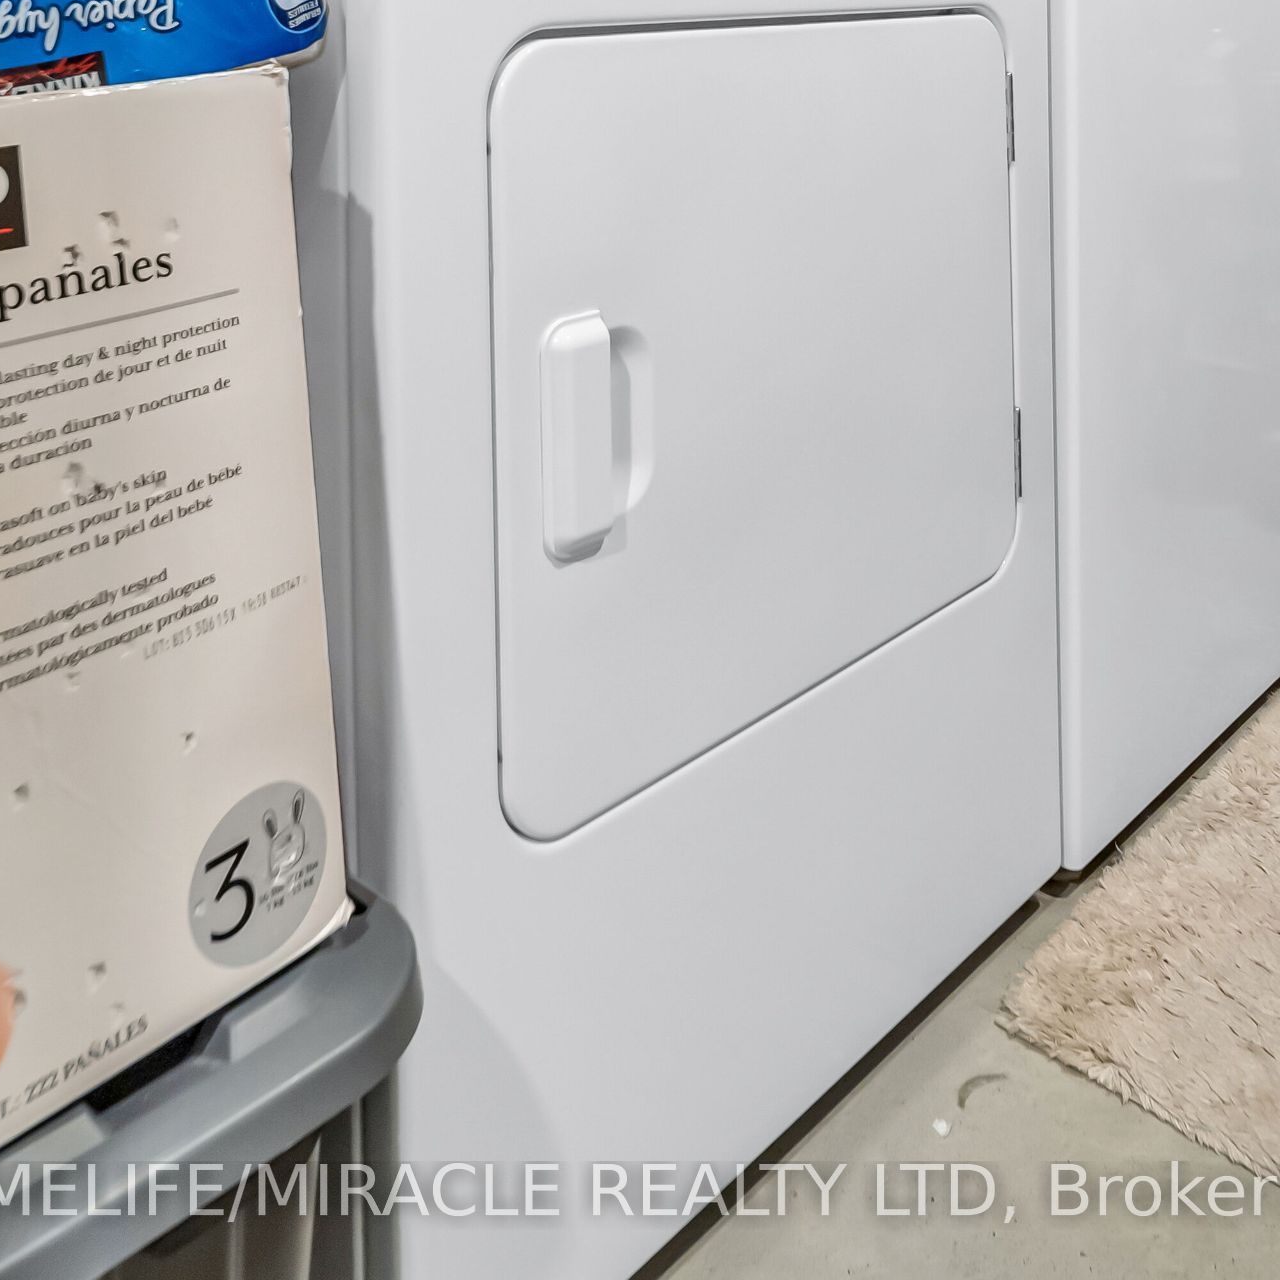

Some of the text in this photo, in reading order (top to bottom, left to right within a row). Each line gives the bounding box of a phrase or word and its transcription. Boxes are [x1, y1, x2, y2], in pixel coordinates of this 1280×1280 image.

[63, 350, 93, 372] day
[98, 345, 111, 361] &
[115, 334, 159, 358] night
[162, 314, 241, 347] protection
[93, 366, 114, 385] de
[116, 359, 153, 383] jour
[156, 352, 170, 368] et
[174, 347, 193, 363] de
[196, 338, 228, 358] nuit
[60, 408, 121, 436] diurna
[124, 406, 136, 423] y
[138, 384, 210, 415] nocturna
[213, 375, 232, 392] de
[9, 436, 93, 471] duración
[48, 500, 71, 517] on
[73, 478, 130, 508] baby's
[133, 468, 168, 490] skin
[79, 506, 123, 536] pour
[125, 498, 141, 516] la
[145, 485, 183, 511] peau
[186, 477, 206, 493] de
[208, 463, 243, 486] bébé
[68, 540, 91, 557] en
[94, 531, 111, 549] la
[114, 519, 147, 545] piel
[149, 509, 174, 529] del
[177, 494, 215, 520] bebé
[121, 567, 169, 598] tested
[37, 630, 68, 658] par
[70, 619, 99, 639] des
[101, 572, 217, 627] dermatologues
[157, 592, 219, 634] probado
[205, 837, 255, 944] 3
[24, 1071, 60, 1105] 222
[61, 1013, 150, 1084] PAÑALES
